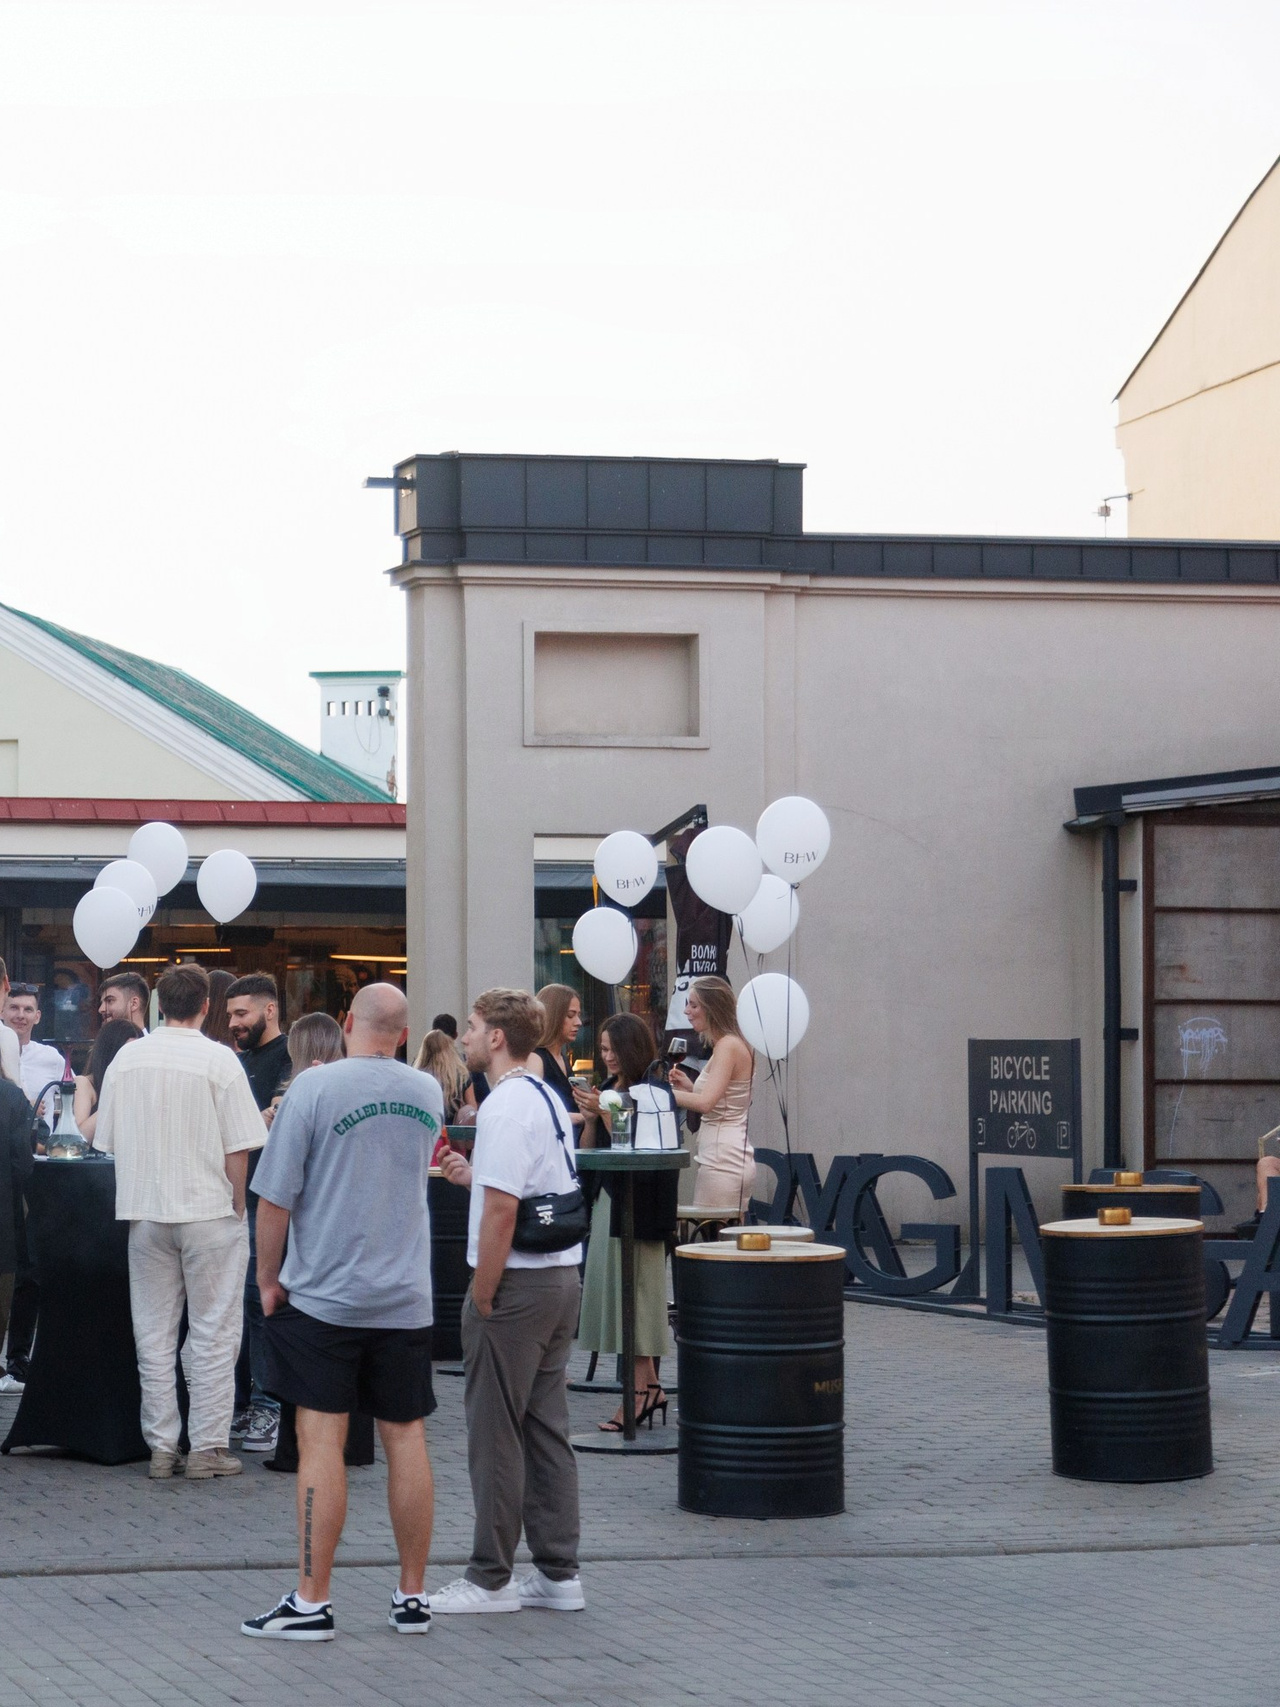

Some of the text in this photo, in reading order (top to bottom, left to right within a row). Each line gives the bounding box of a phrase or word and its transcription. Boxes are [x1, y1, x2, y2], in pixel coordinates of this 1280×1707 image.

[990, 1055, 1050, 1080] BICYCLE
[989, 1089, 1053, 1115] PARKING
[333, 1103, 378, 1136] CALLED
[379, 1102, 388, 1115] A
